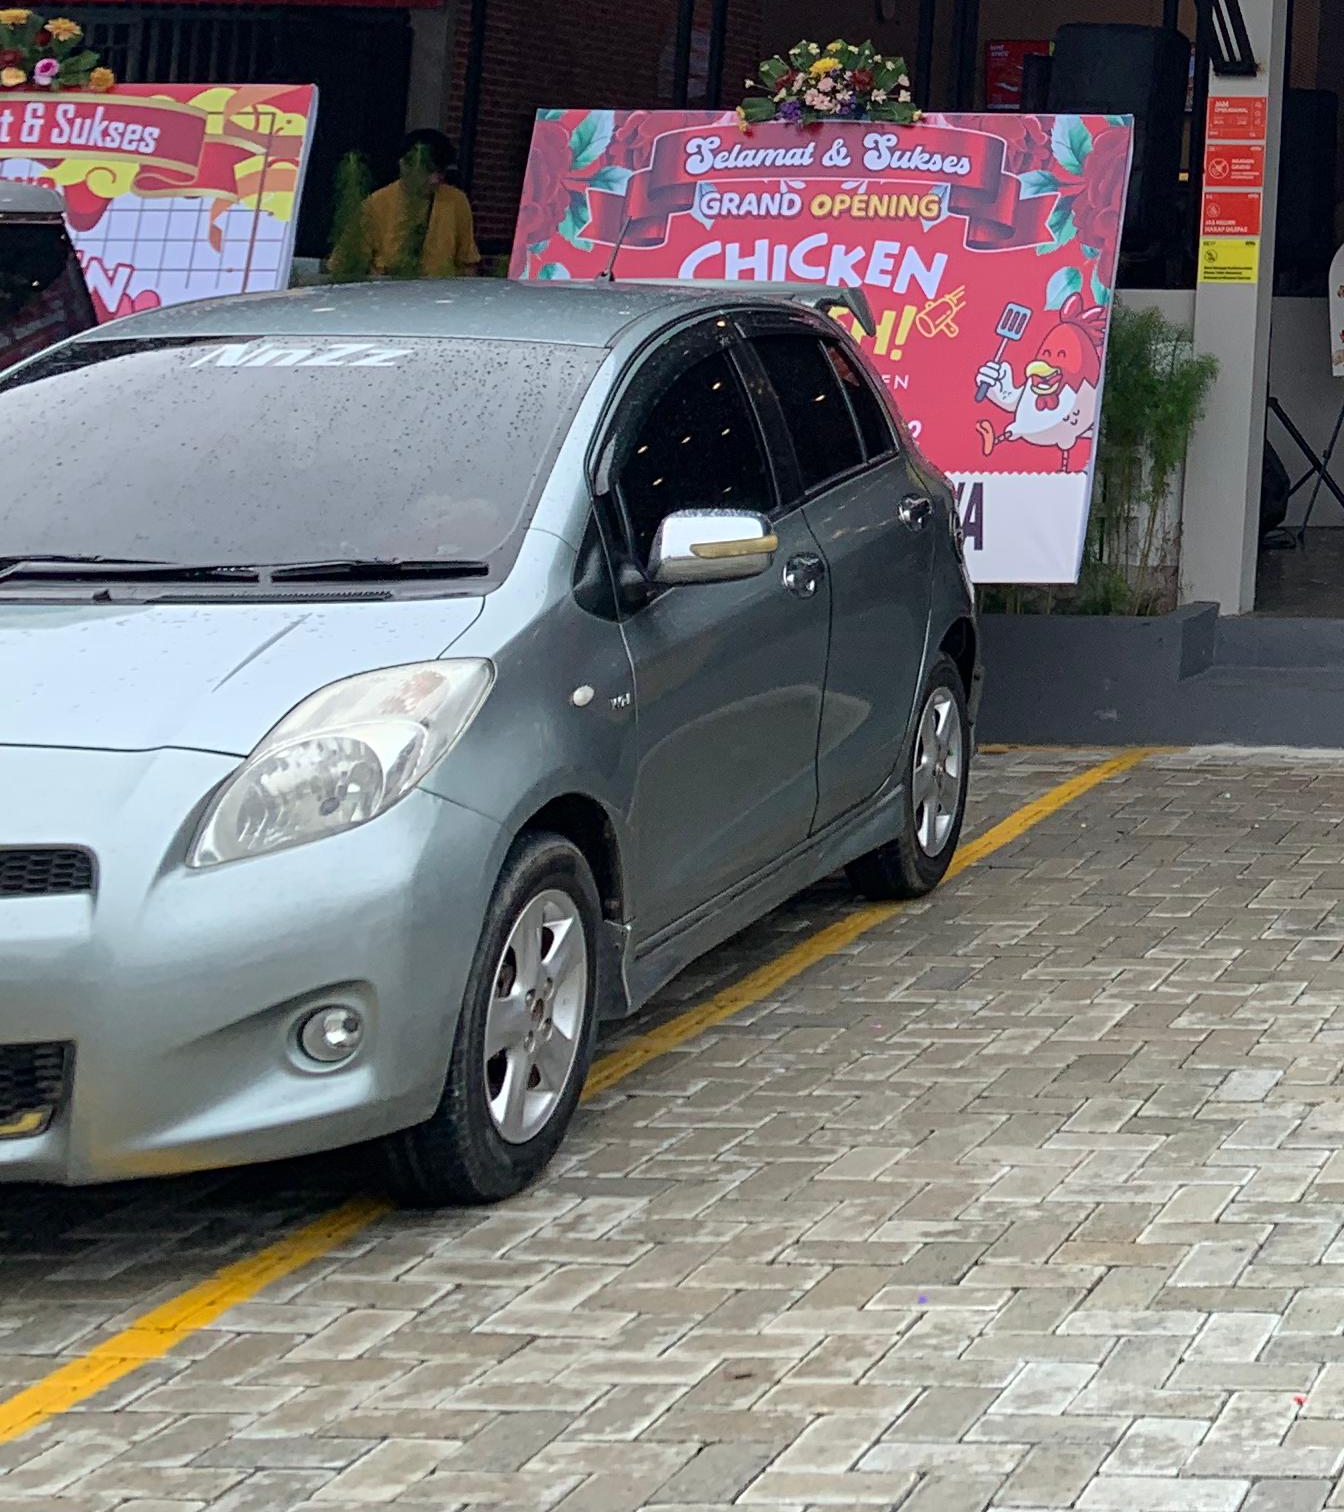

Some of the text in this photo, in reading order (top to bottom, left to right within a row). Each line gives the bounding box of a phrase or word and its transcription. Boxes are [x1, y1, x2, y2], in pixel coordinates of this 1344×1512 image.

[20, 101, 45, 144] &
[51, 103, 161, 155] Sukses
[685, 132, 971, 176] Selamat & Sukses
[700, 192, 941, 218] GRAND OPENING
[678, 232, 949, 300] CHICKEN
